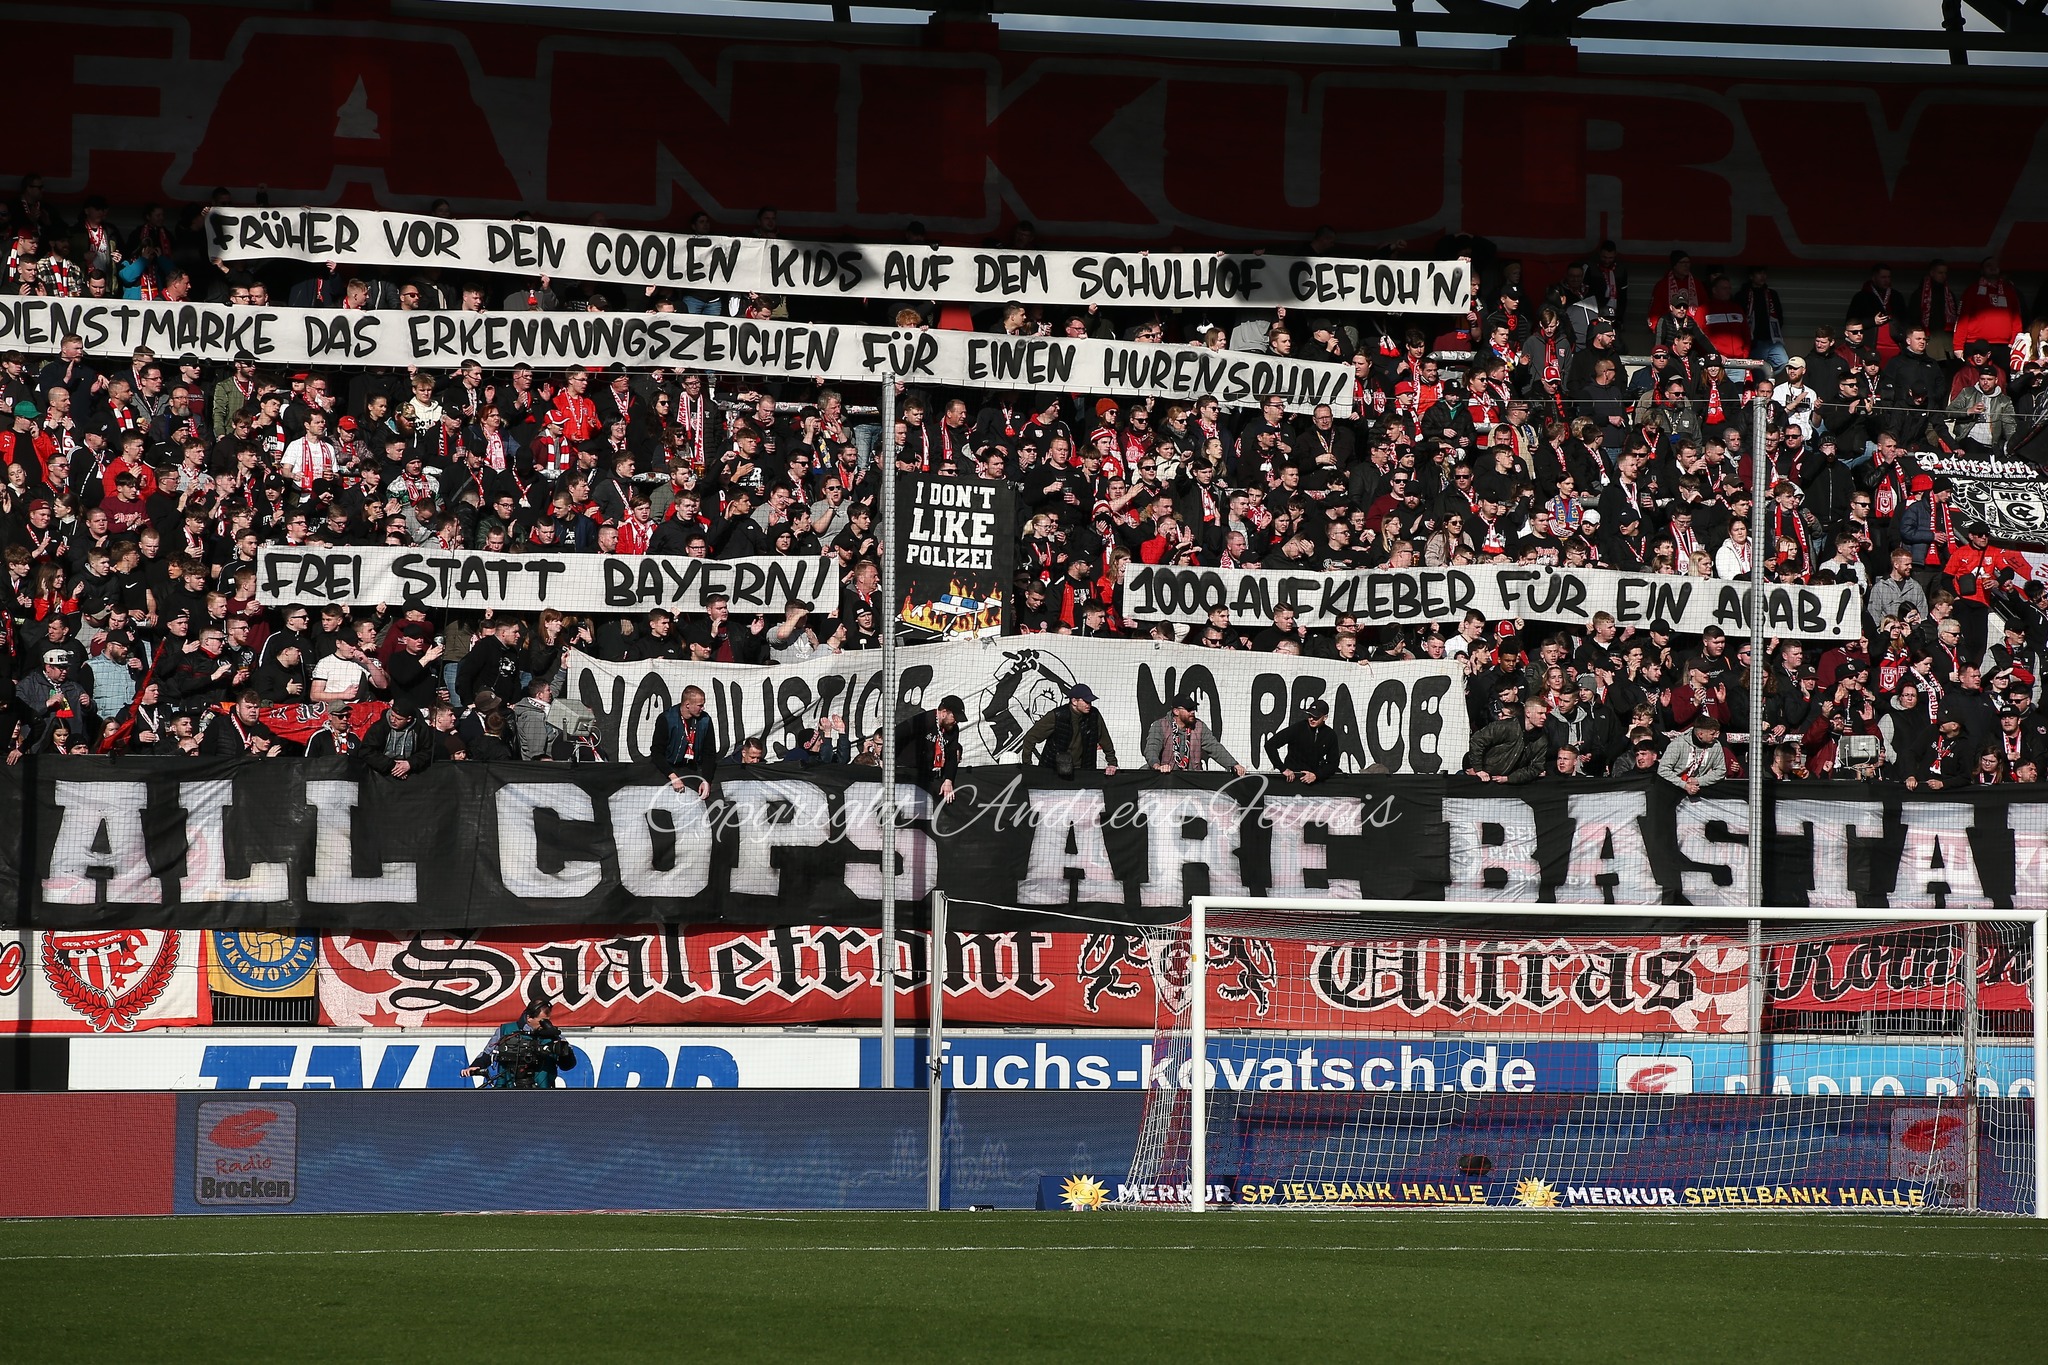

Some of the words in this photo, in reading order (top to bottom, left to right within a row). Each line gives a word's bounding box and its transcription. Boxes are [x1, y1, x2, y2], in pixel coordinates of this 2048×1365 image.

[210, 209, 360, 255] FRÜHER
[383, 219, 461, 259] VOR
[488, 225, 566, 269] DEN
[587, 232, 742, 287] COOLEN
[770, 245, 864, 292] KIDS
[884, 250, 956, 293] AUF
[975, 254, 1049, 296] DEM
[1071, 258, 1265, 302] SCHULHOF
[0, 300, 278, 355] DIENSTMARKE
[305, 315, 381, 358] DAS
[409, 314, 840, 371] ERKENNUNGSZEICHEN
[863, 330, 940, 377] FÜR
[968, 339, 1075, 385] EINEN
[1104, 349, 1349, 405] HURENSOHN!
[915, 481, 924, 504] I
[929, 482, 996, 510] DON'T
[1999, 491, 2033, 501] HFC
[909, 507, 995, 546] LIKE
[906, 543, 993, 570] POLIZEI
[261, 553, 364, 600] FREI
[392, 553, 567, 602] STATT
[603, 555, 832, 607] BAYERN!
[1129, 566, 1229, 616] 1000
[1496, 566, 1589, 618] FÜR
[1617, 578, 1692, 631] EIN
[42, 779, 418, 905] ALL
[495, 780, 938, 905] COPS
[1017, 786, 1365, 907] ARE
[215, 1153, 273, 1175] Radio
[201, 1176, 291, 1199] Brocken
[1402, 1183, 1486, 1203] HALLE
[1567, 1185, 1677, 1205] MERKUR
[1684, 1186, 1831, 1206] SPIELBANK
[1839, 1187, 1925, 1207] HALLE
